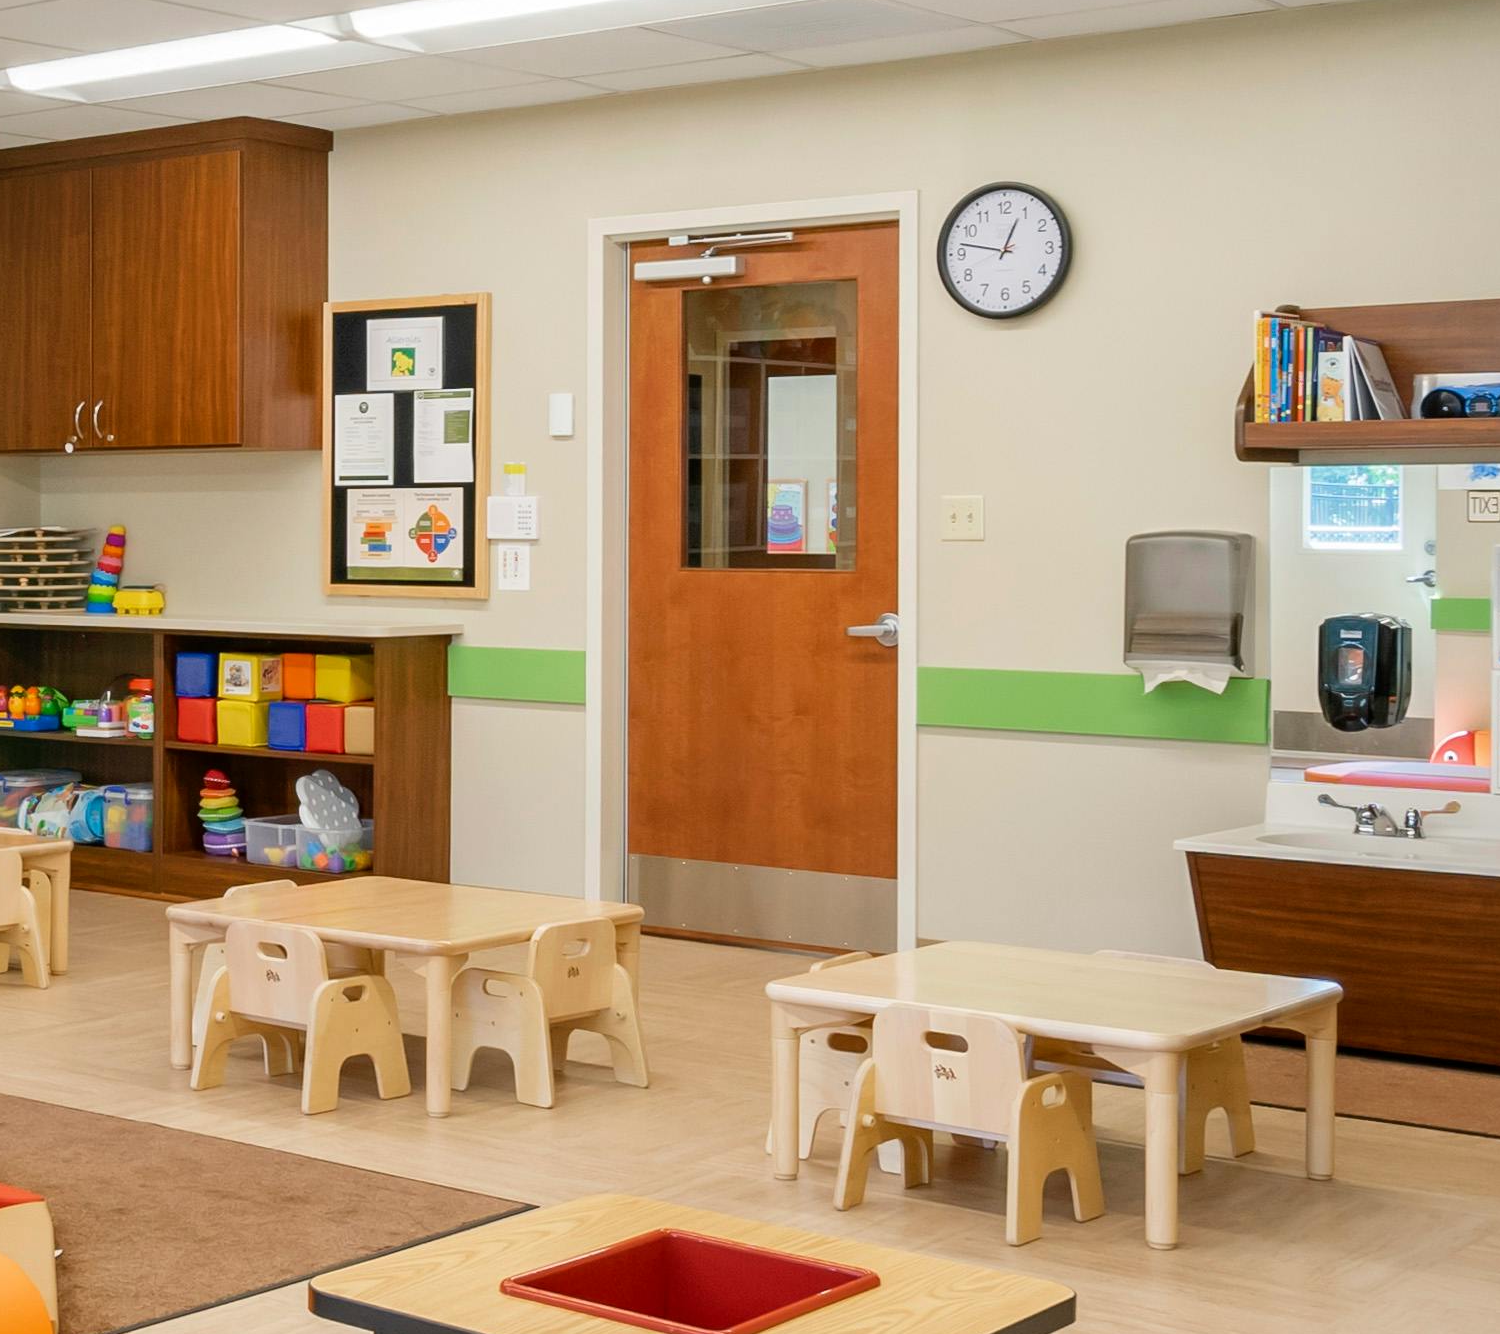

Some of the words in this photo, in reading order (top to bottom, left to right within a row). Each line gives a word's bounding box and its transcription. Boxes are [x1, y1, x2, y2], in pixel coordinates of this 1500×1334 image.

[998, 200, 1012, 214] 12
[1022, 206, 1028, 219] 1
[977, 210, 990, 223] 11
[963, 224, 977, 238] 10
[1037, 219, 1047, 232] 2
[957, 247, 966, 261] 9
[1045, 240, 1054, 255] 3
[964, 268, 973, 282] 8
[1038, 263, 1046, 276] 4
[980, 283, 989, 296] 7
[1001, 287, 1010, 301] 6
[1022, 280, 1031, 294] 5
